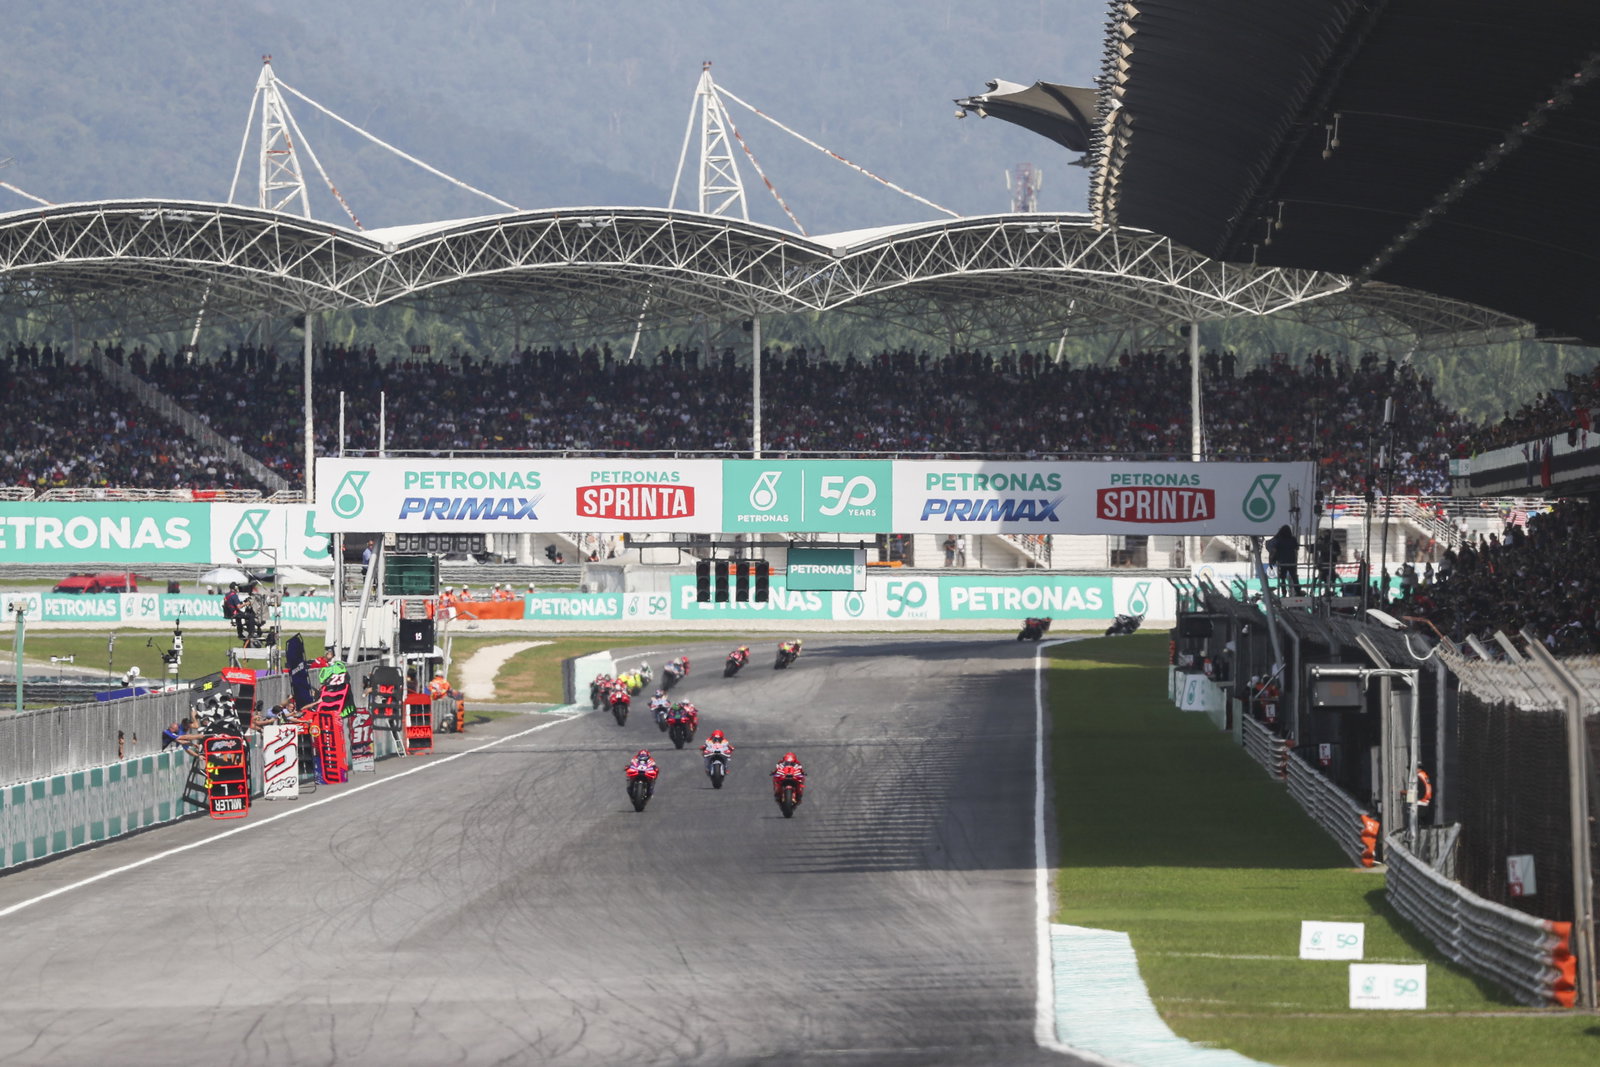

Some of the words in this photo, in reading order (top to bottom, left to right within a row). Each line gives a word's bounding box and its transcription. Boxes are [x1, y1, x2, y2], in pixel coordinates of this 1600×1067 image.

[404, 471, 541, 490] PETRONAS
[590, 470, 680, 483] PETRONAS
[926, 473, 1062, 491] PETRONAS
[1111, 473, 1200, 486] PETRONAS
[583, 487, 687, 516] SPRINTA
[819, 475, 877, 516] 50
[399, 495, 545, 520] PRIMAX
[920, 497, 1068, 522] PRIMAX
[1104, 491, 1208, 520] SPRINTA
[737, 514, 789, 523] PETRONAS
[0, 516, 190, 549] TRONAS
[790, 564, 852, 574] PETRONAS
[46, 598, 117, 616] PETRONAS
[530, 598, 618, 616] PETRONAS
[887, 580, 927, 618] 50
[951, 586, 1103, 611] PETRONAS
[329, 674, 345, 685] 23
[407, 728, 431, 737] ACOSTA
[214, 799, 242, 812] MILLER
